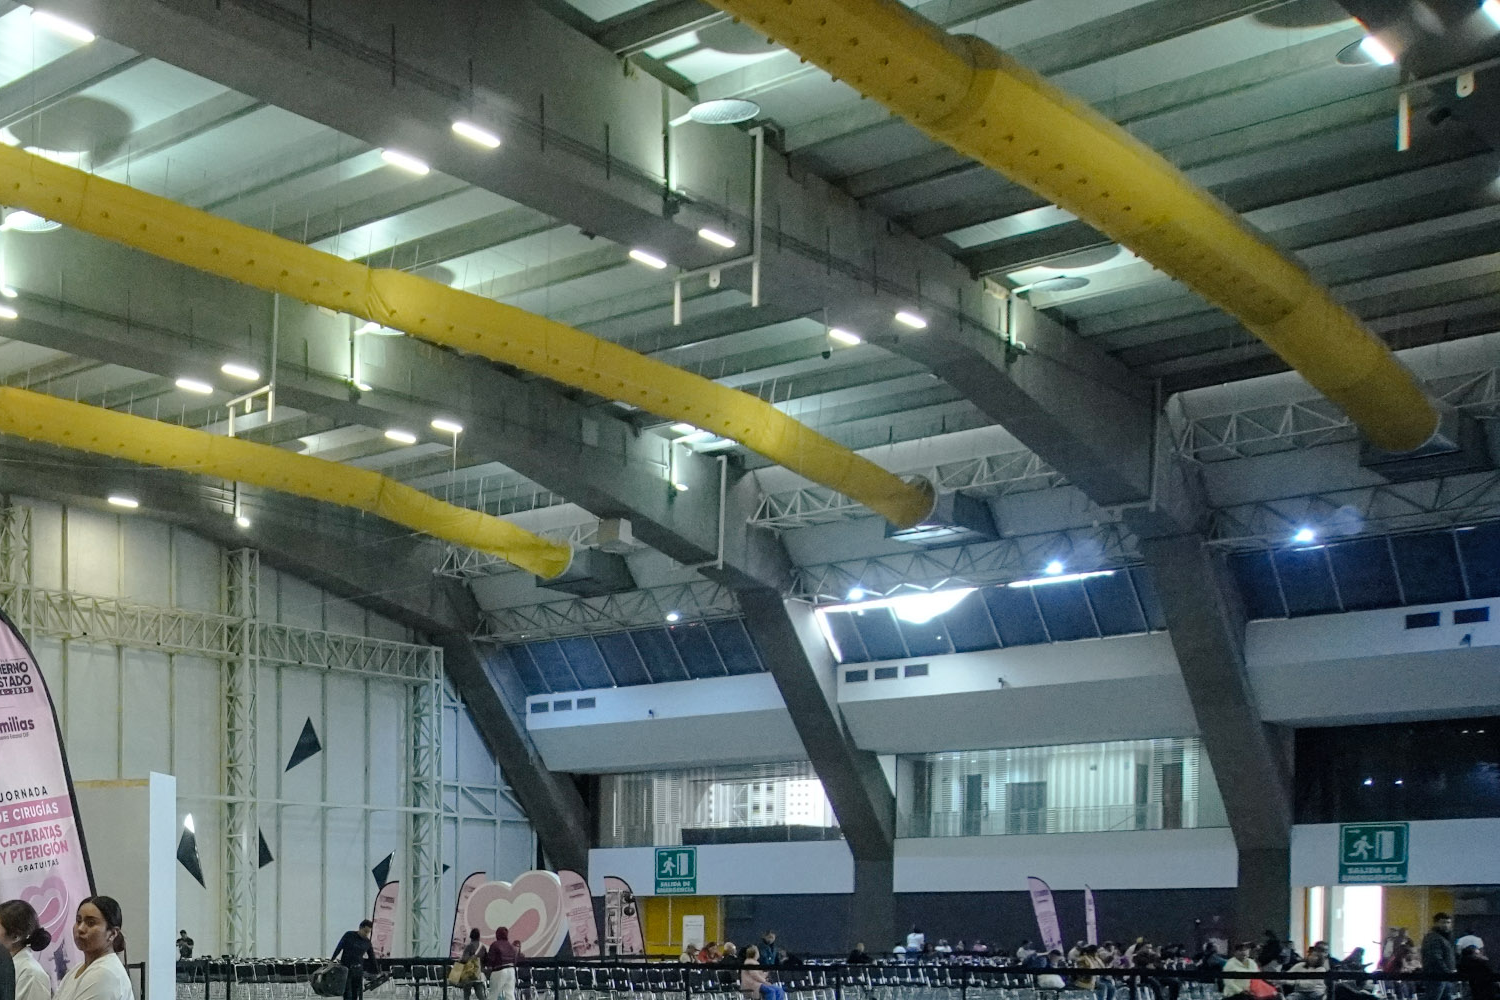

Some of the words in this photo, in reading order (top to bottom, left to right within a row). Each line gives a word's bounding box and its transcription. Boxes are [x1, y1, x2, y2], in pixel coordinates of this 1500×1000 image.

[0, 786, 48, 803] JORNADA
[12, 801, 59, 820] CIRUGÍAS
[0, 824, 63, 848] CATARATAS
[0, 851, 7, 865] Y
[10, 838, 69, 864] PTERIGIÓN
[17, 858, 60, 873] GRATUITAS
